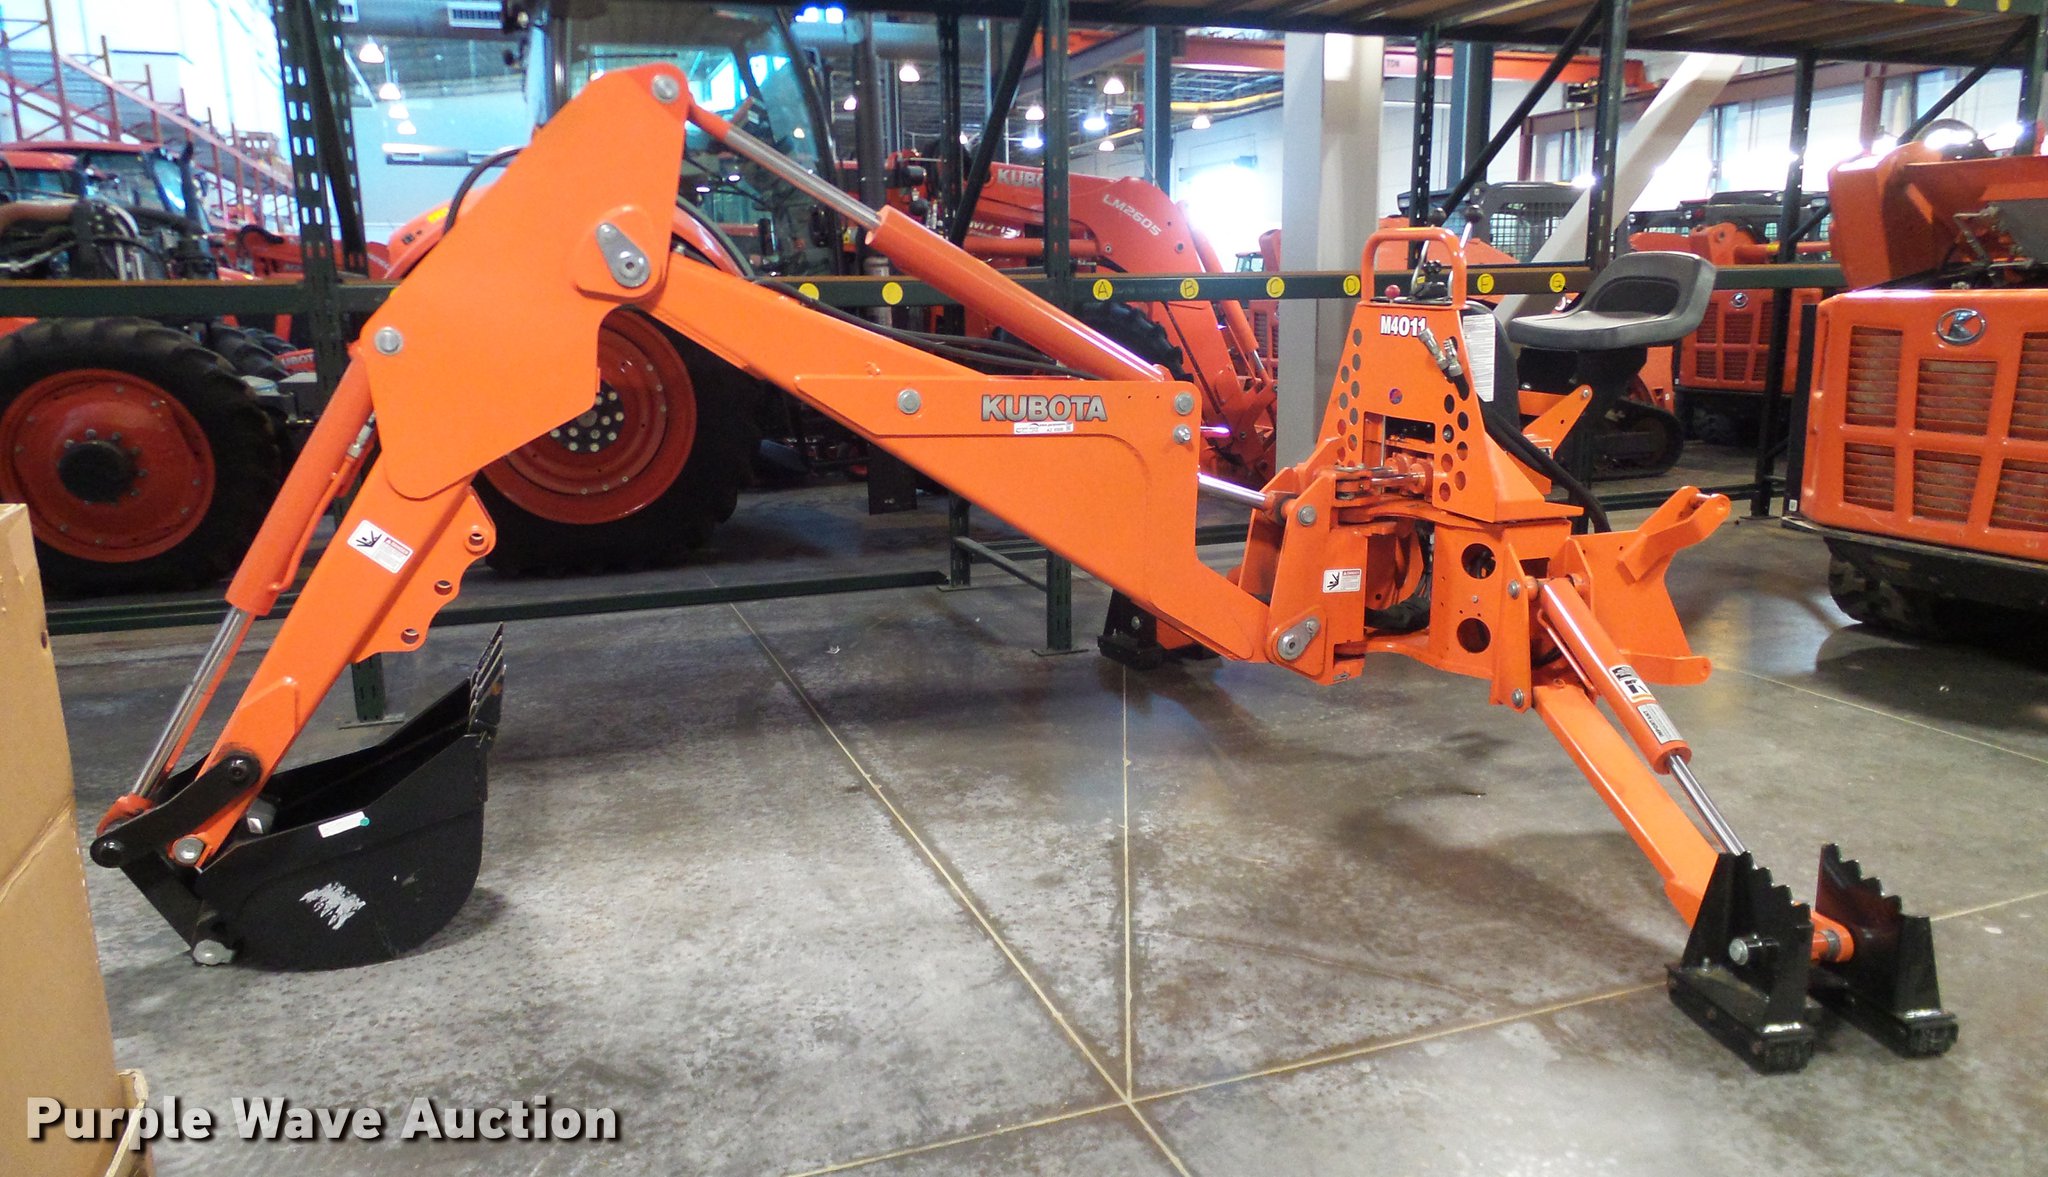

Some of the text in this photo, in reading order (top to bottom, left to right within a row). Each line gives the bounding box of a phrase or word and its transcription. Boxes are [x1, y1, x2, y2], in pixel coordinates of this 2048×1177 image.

[997, 168, 1043, 190] KUBO
[1103, 193, 1162, 236] LM2605
[1380, 314, 1427, 337] M4011
[281, 353, 315, 368] UBOT
[981, 394, 1108, 422] KUBOTA
